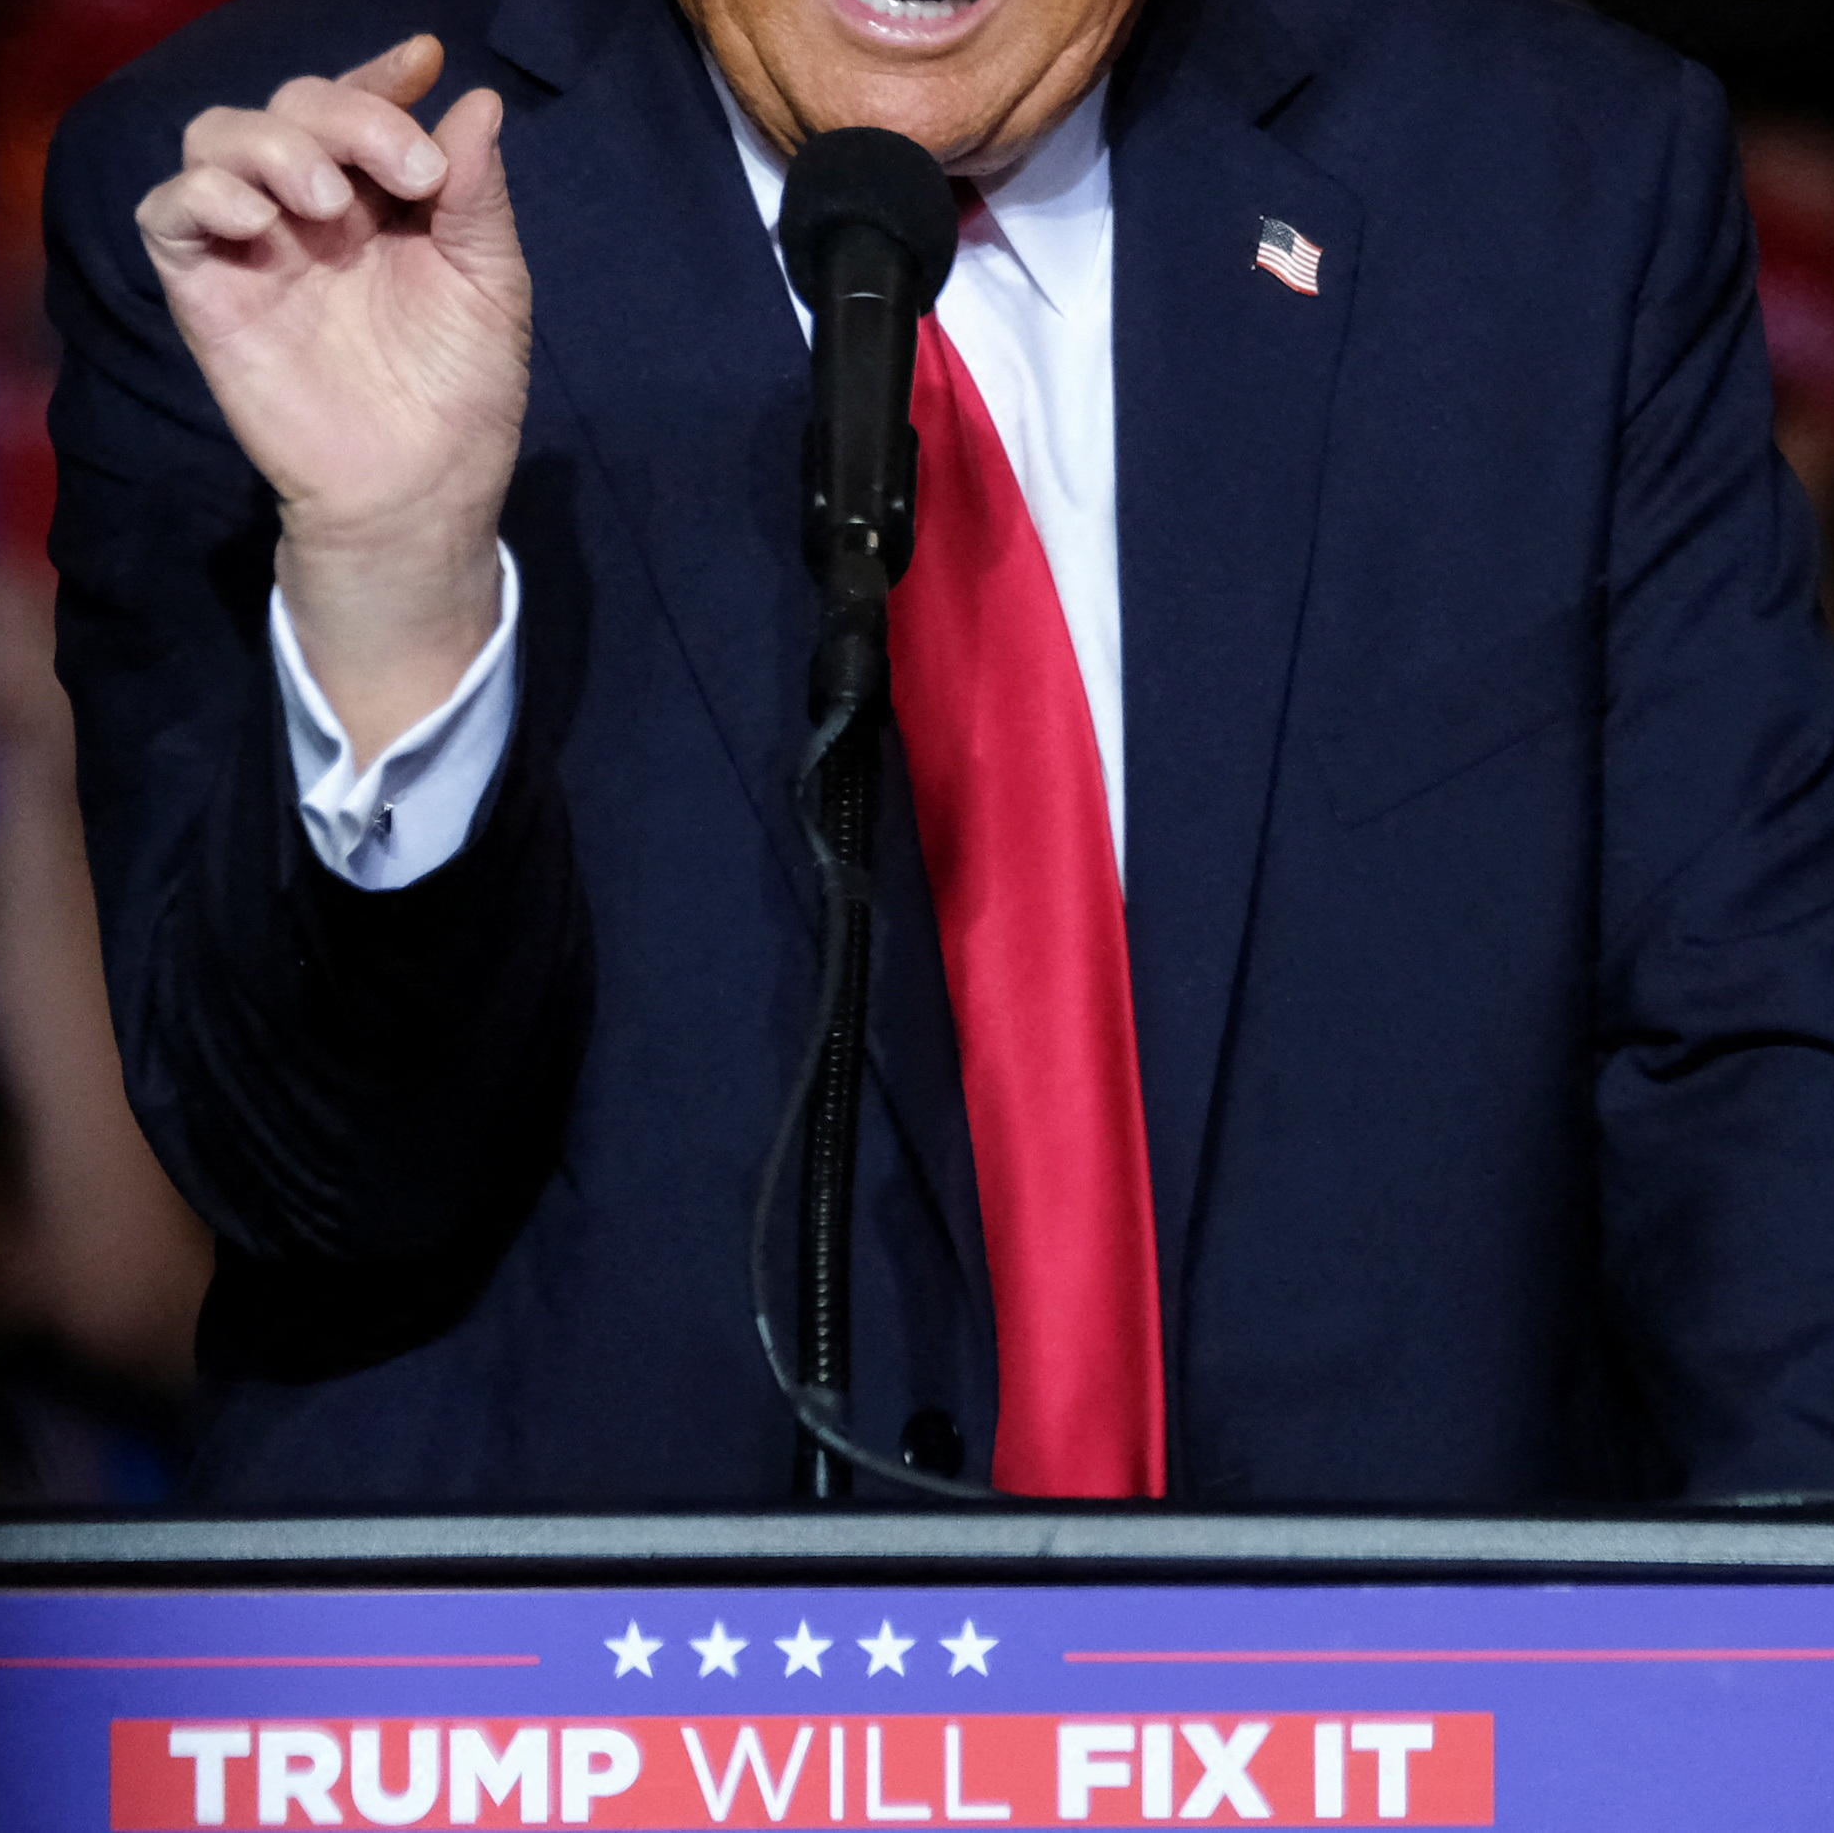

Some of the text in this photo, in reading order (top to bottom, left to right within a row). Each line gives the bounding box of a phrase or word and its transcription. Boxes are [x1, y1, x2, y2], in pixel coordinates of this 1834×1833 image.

[168, 1718, 1435, 1826] TRUMP WILL FIX IT
